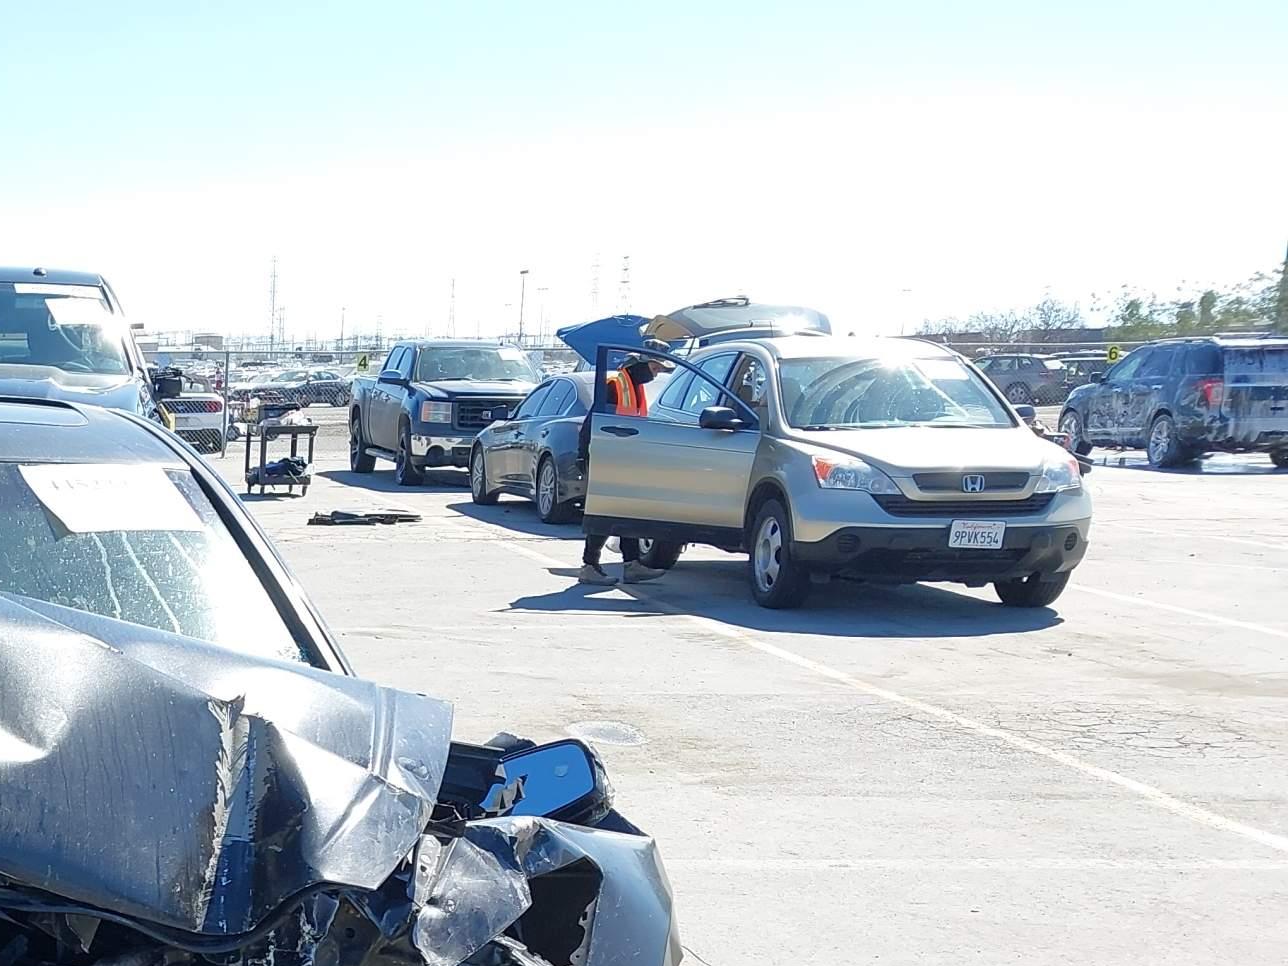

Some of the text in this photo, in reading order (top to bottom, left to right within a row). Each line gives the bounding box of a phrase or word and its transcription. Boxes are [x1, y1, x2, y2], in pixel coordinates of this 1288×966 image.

[1109, 346, 1118, 361] 6
[358, 355, 369, 369] 4
[952, 530, 999, 545] 9PVK554
